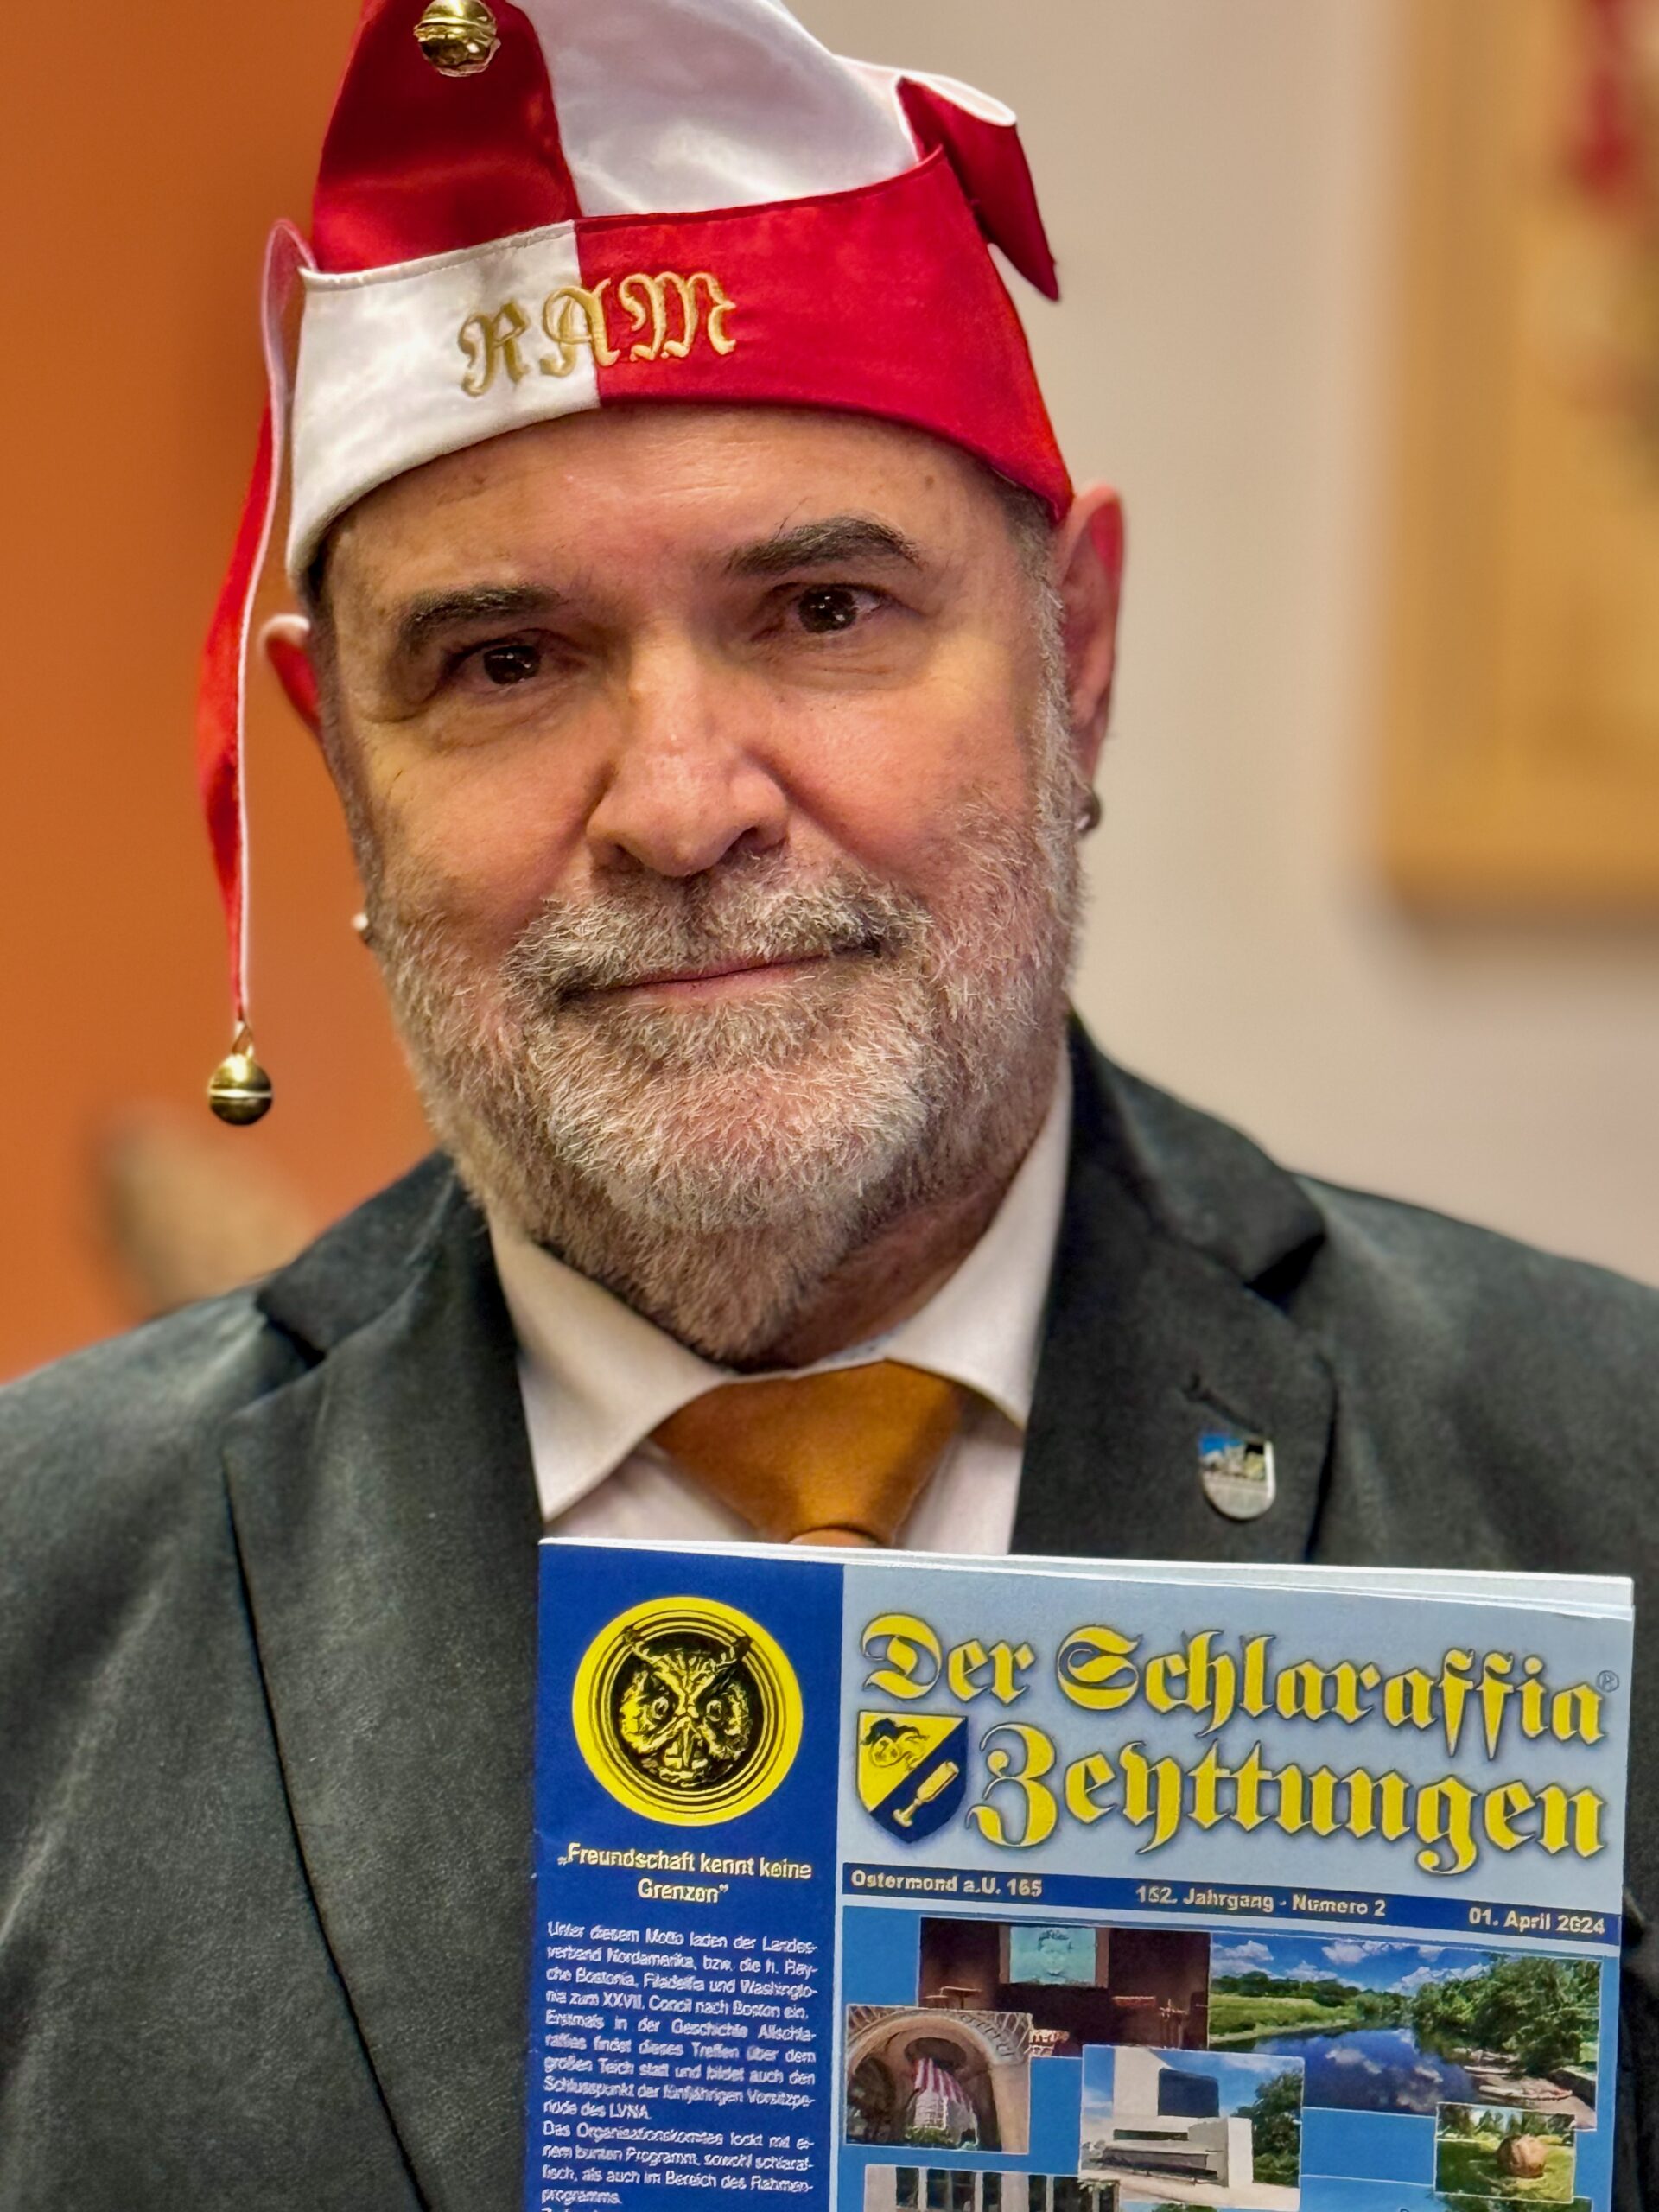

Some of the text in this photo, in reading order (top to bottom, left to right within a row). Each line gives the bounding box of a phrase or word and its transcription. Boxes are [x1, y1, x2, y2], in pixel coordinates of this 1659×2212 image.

[861, 1613, 1035, 1707] Der
[969, 1723, 1607, 1876] Zeyttungen
[700, 1853, 754, 1876] kennt
[760, 1858, 812, 1879] keine
[850, 1869, 1043, 1897] Ostermond a.U. 165
[1183, 1888, 1274, 1913] Jahrgang
[1292, 1893, 1369, 1915] Numero
[1373, 1899, 1386, 1916] 2
[1469, 1907, 1605, 1935] 01. April 2024
[548, 1921, 818, 1954] Unter diesem Motto laden der Landes-
[547, 1945, 602, 1961] verband
[740, 1957, 761, 1973] die
[546, 1967, 572, 1981] che
[709, 1979, 735, 1993] und
[569, 1992, 600, 2006] zum
[695, 1999, 728, 2015] nach
[733, 2000, 780, 2018] Boston
[545, 2009, 605, 2030] Erstmals
[614, 2015, 628, 2031] in
[638, 2016, 660, 2032] der
[671, 2018, 748, 2038] Geschichte
[594, 2035, 632, 2053] findet
[639, 2039, 684, 2056] dieses
[691, 2041, 740, 2059] Treffen
[746, 2044, 779, 2061] über
[785, 2049, 817, 2063] dem
[544, 2054, 816, 2085] großen Teich statt und bildet auch den
[637, 2083, 660, 2098] der
[580, 2101, 607, 2117] des
[543, 2120, 571, 2137] Das
[542, 2145, 572, 2158] nem
[575, 2144, 623, 2161] bunten
[703, 2153, 753, 2168] sowohl
[582, 2166, 603, 2182] als
[607, 2170, 641, 2184] auch
[644, 2170, 661, 2184] im
[665, 2170, 717, 2187] Bereich
[721, 2175, 747, 2190] des
